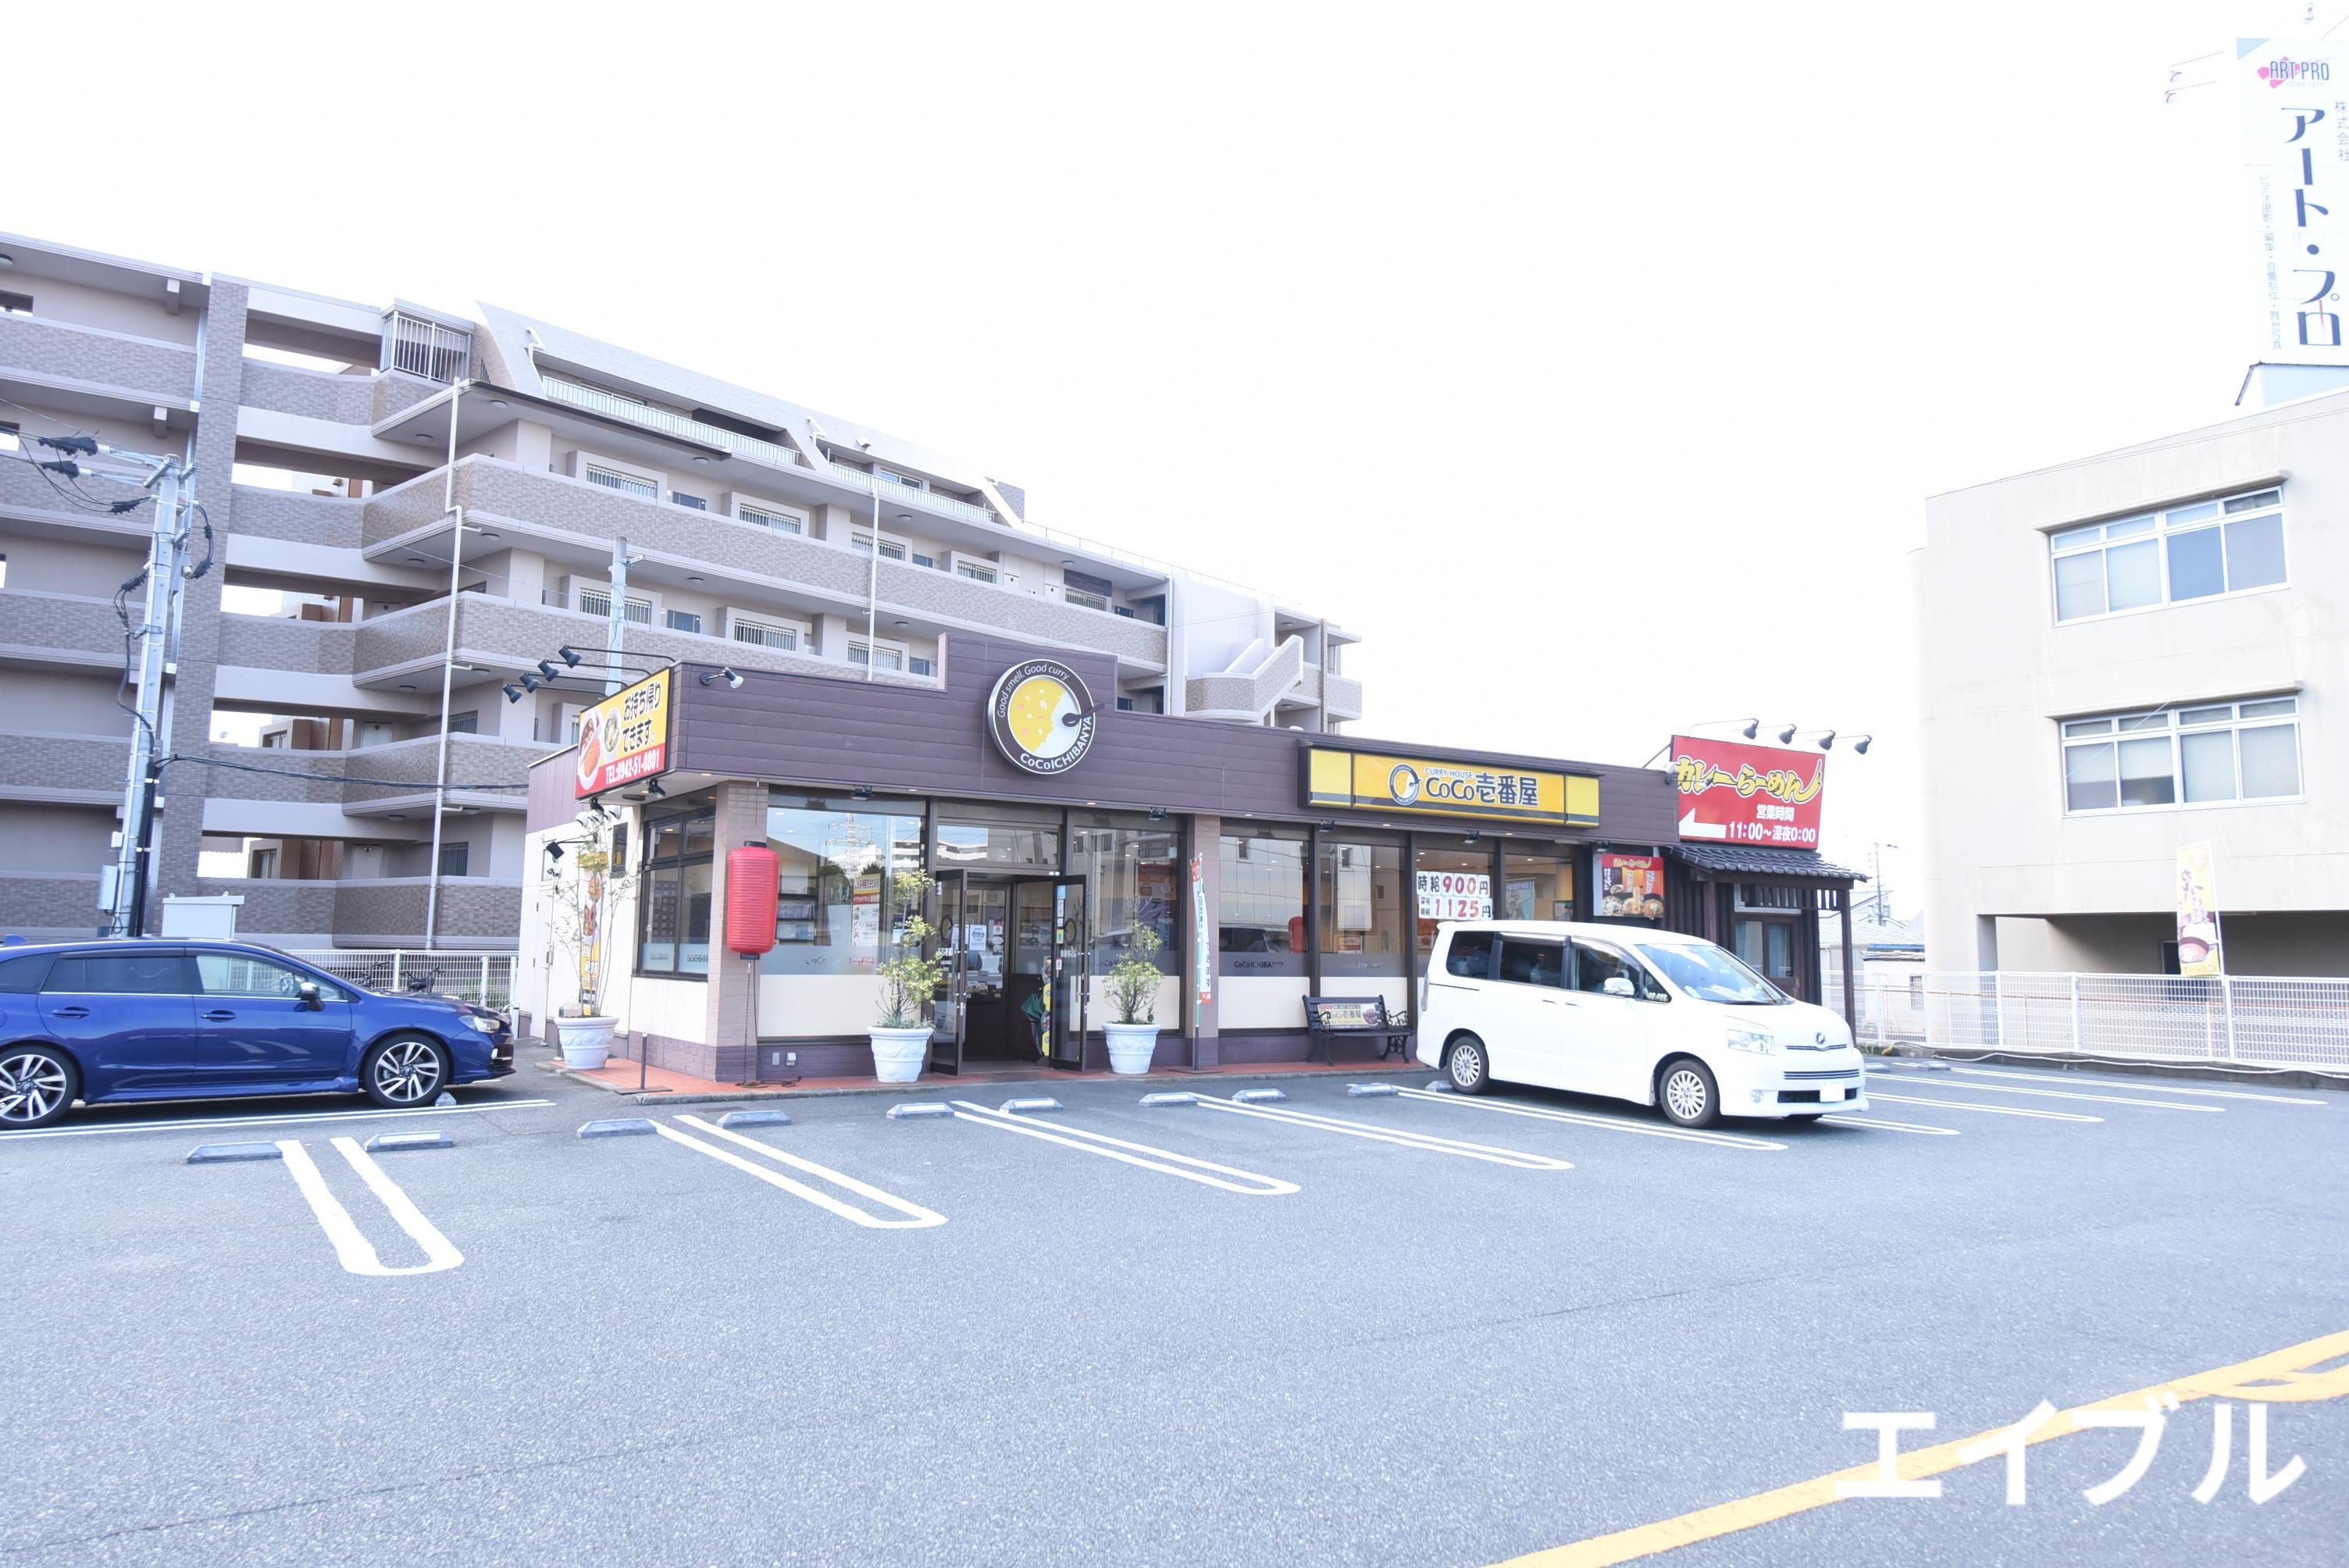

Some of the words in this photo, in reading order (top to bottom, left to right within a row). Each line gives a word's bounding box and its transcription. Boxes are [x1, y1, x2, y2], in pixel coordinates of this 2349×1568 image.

[2301, 62, 2329, 80] PRO
[2280, 107, 2341, 346] アート・プロ
[624, 681, 661, 722] お持ち帰り
[997, 690, 1008, 718] Good
[1006, 670, 1025, 693] smell.
[1024, 664, 1047, 675] Good
[1048, 665, 1070, 681] curry
[622, 718, 655, 753] できます。
[1424, 768, 1447, 776] CURRY
[1449, 770, 1473, 779] HOUSE
[1425, 772, 1538, 806] CoCo壱番屋
[1756, 804, 1795, 821] 営業時間
